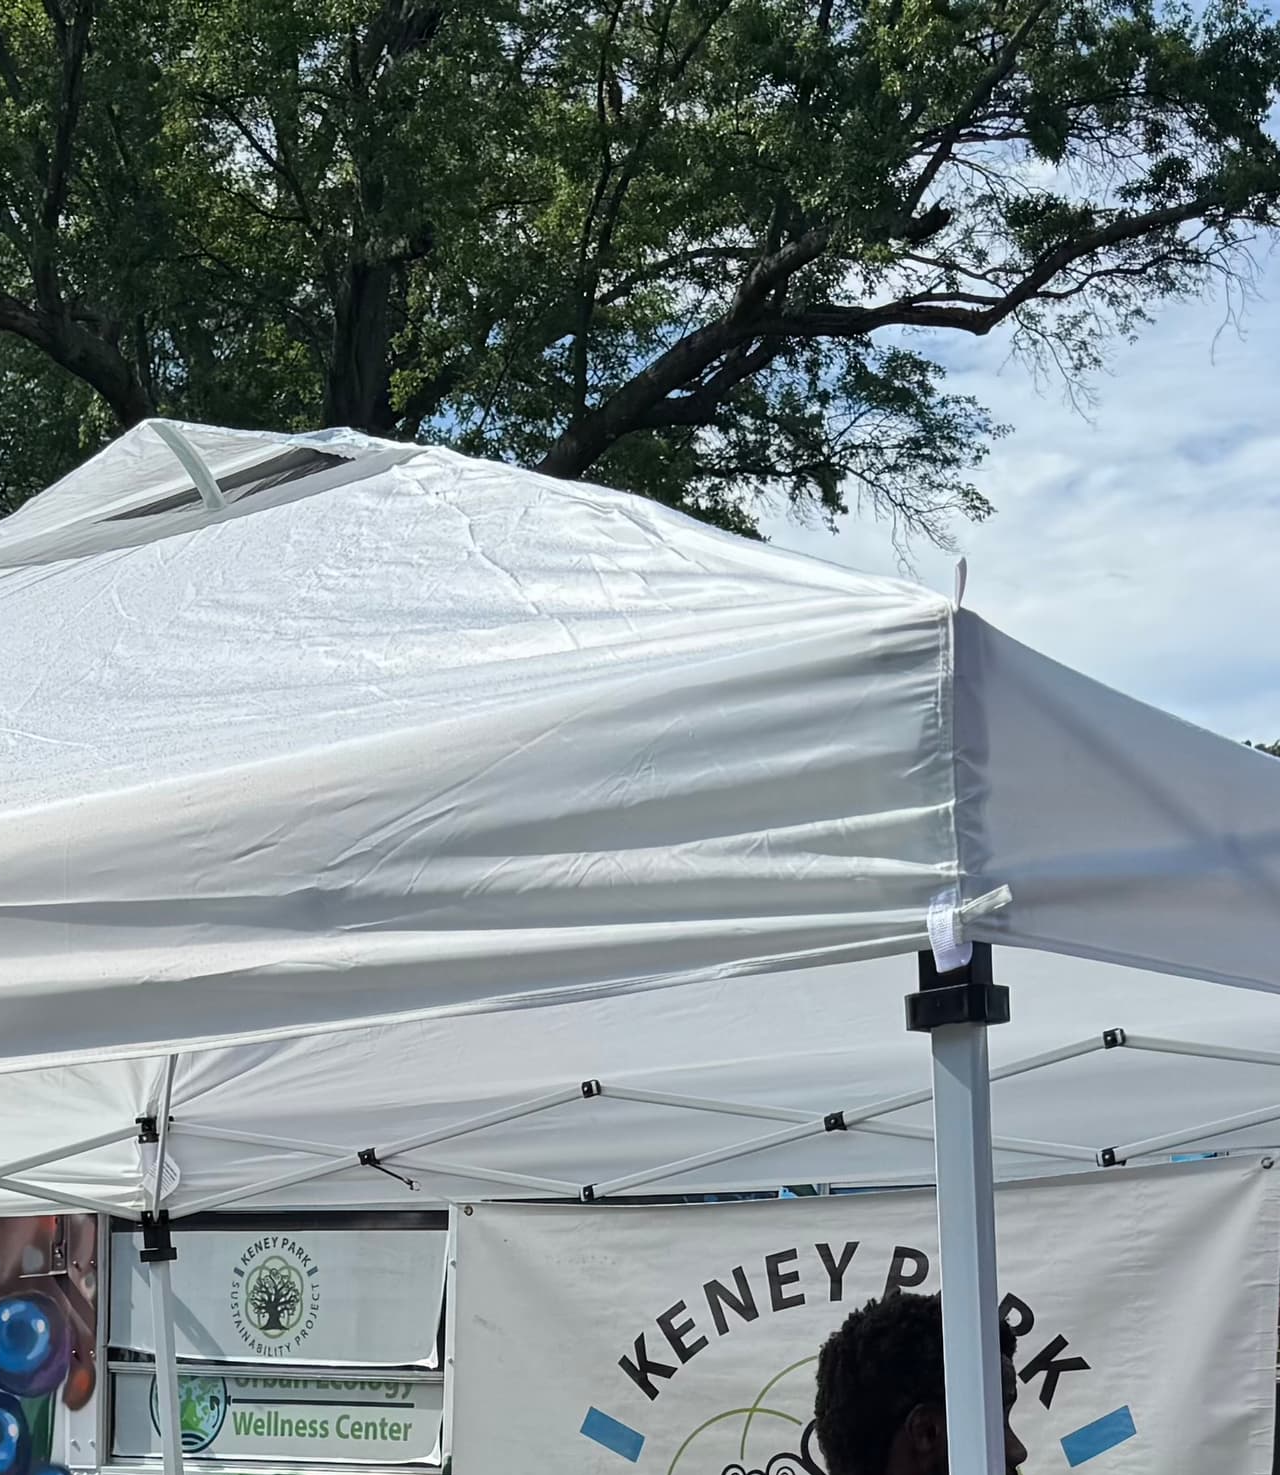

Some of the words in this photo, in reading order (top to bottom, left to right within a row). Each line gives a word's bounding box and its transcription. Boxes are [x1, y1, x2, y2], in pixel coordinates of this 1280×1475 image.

[241, 1236, 279, 1266] KENEY
[281, 1237, 312, 1268] PARK
[230, 1280, 292, 1358] SUSTAINABILITY
[294, 1282, 320, 1346] PROJECT
[618, 1240, 860, 1401] KENEY
[882, 1244, 1091, 1408] PRK
[232, 1411, 330, 1439] Wellness
[335, 1414, 413, 1442] Center
